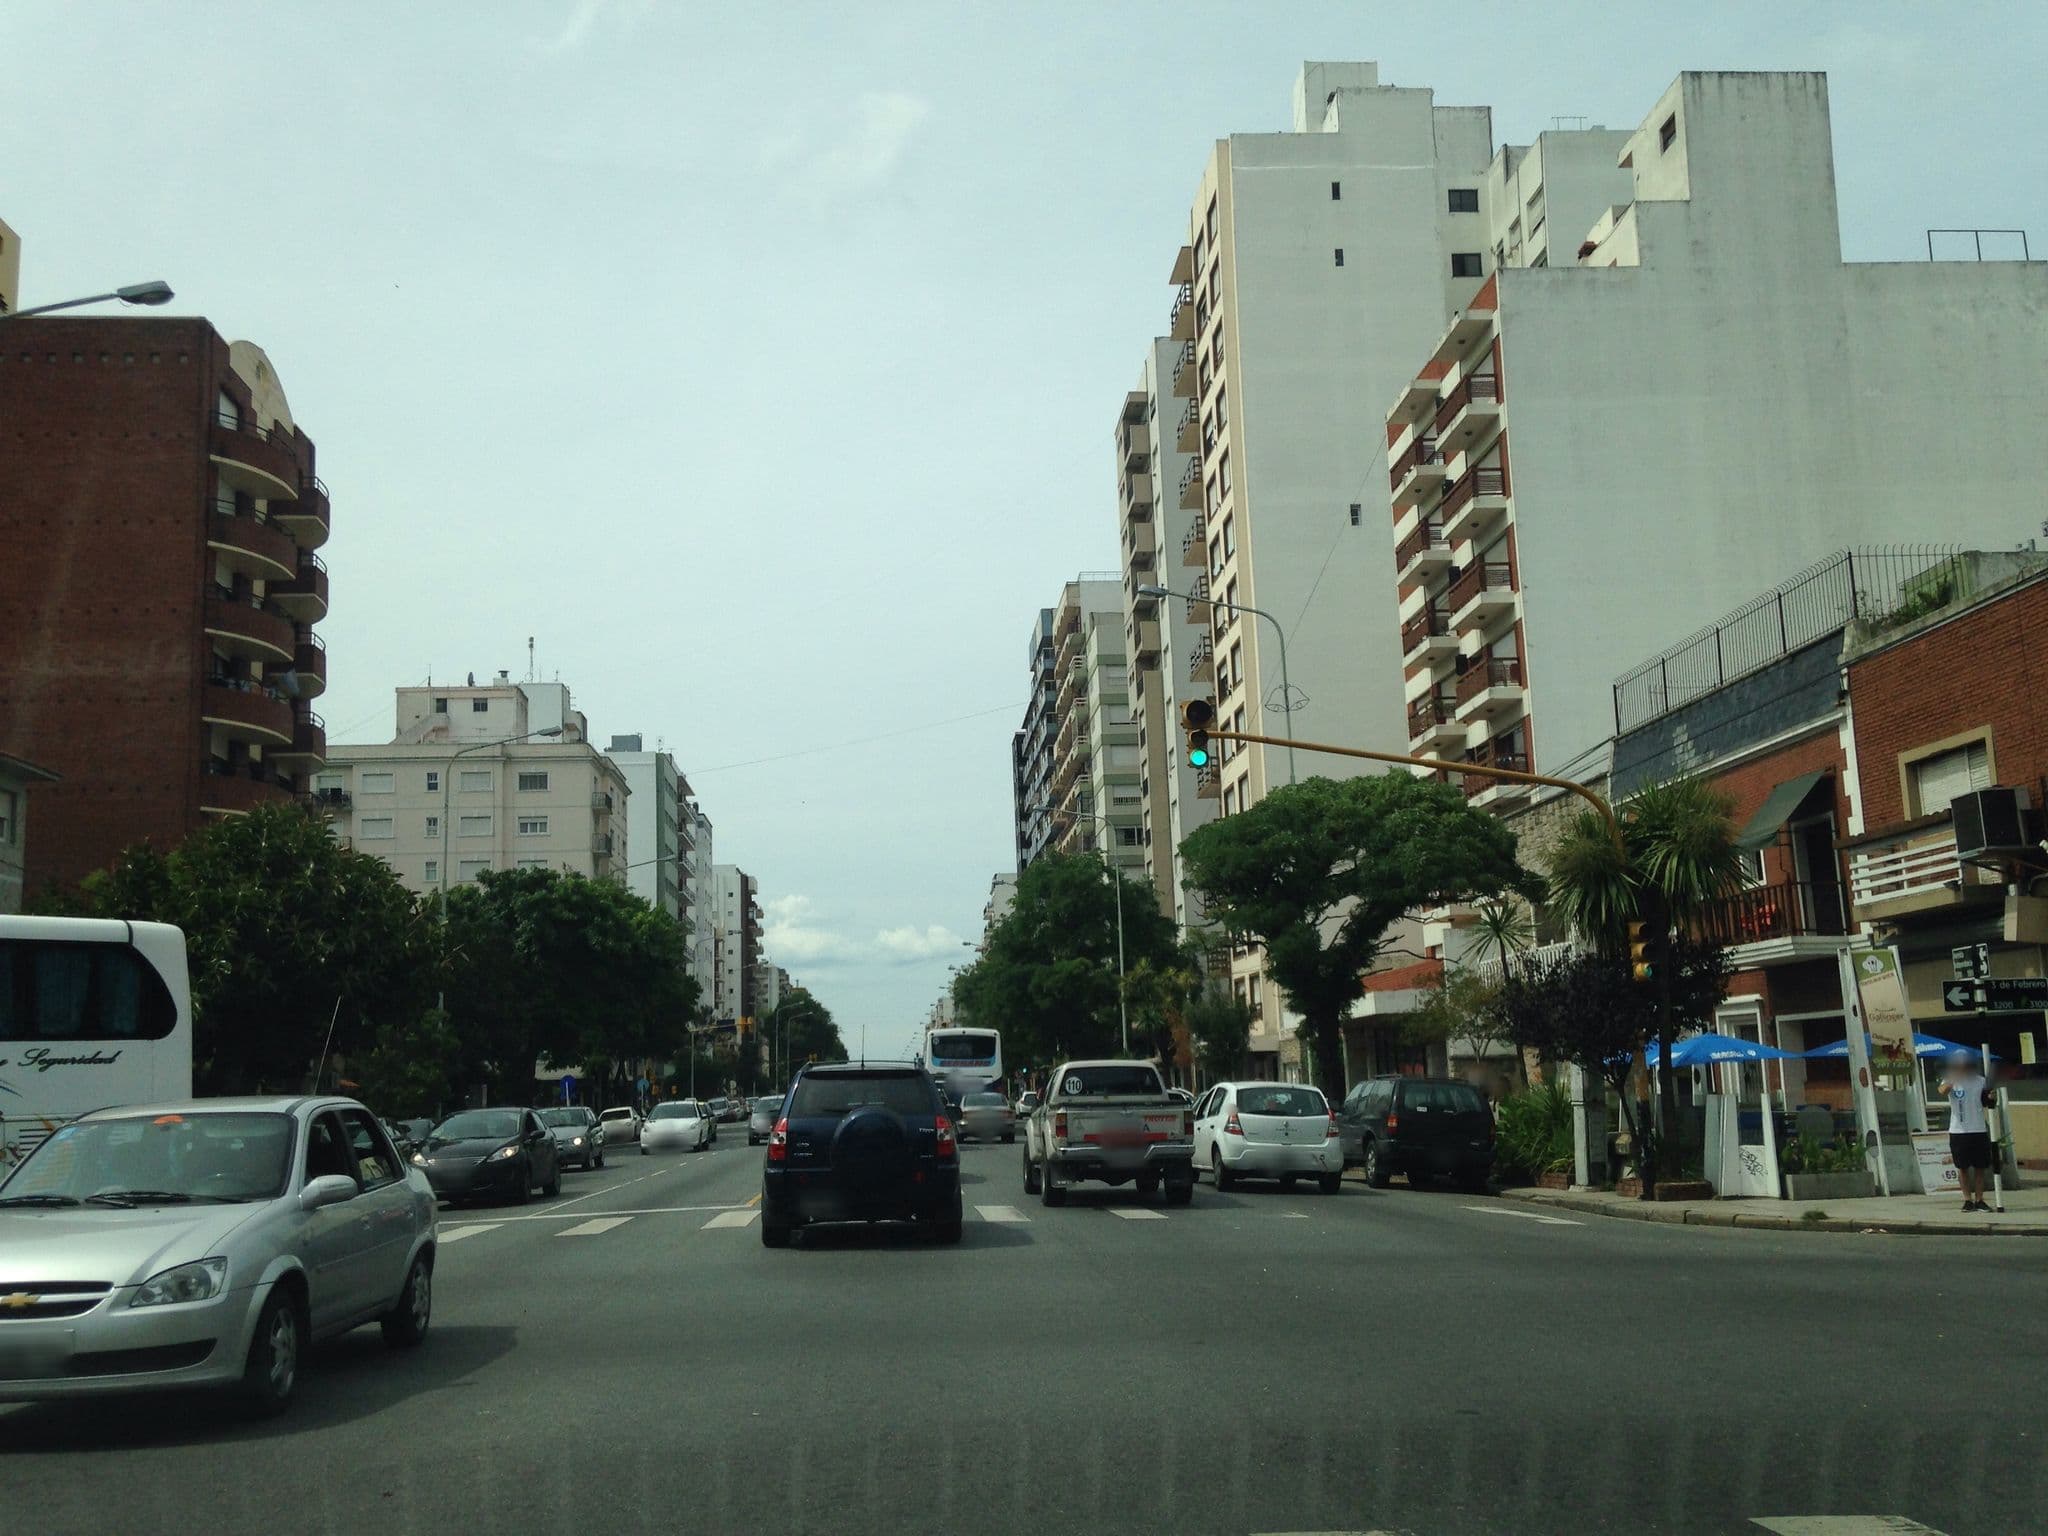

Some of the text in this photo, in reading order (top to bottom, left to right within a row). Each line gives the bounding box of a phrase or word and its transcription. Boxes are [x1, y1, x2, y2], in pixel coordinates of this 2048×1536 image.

[1991, 980, 2046, 989] 3 de Febrero
[18, 1048, 123, 1072] Seguridad
[1067, 1079, 1081, 1091] 110
[1945, 1170, 1958, 1180] 69
